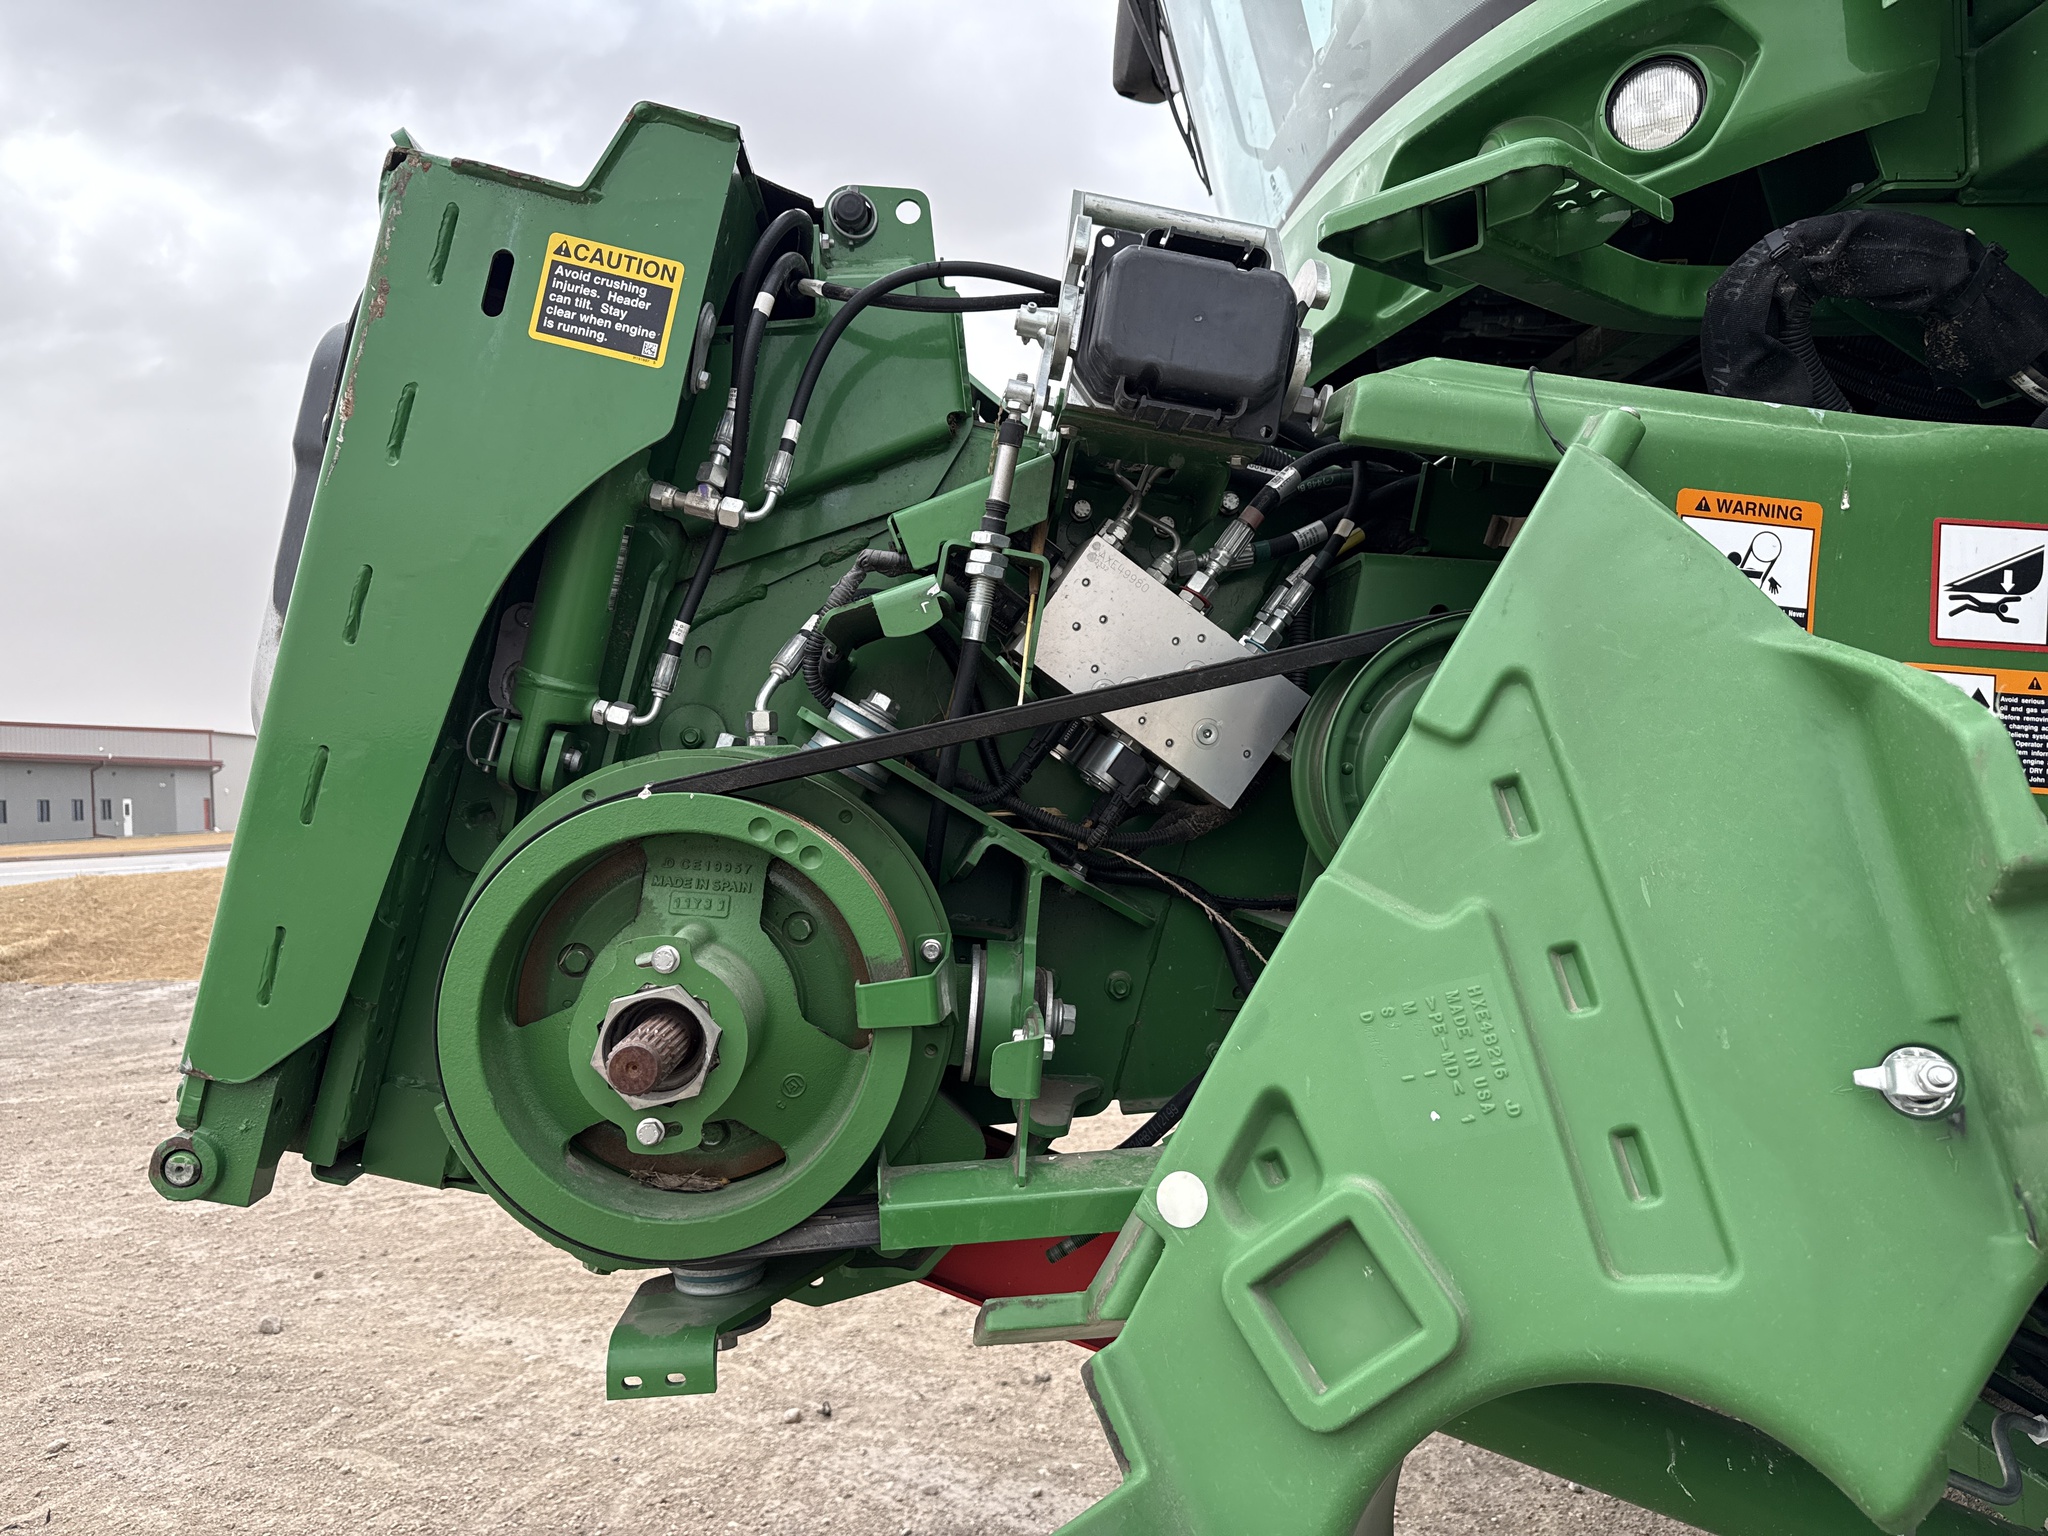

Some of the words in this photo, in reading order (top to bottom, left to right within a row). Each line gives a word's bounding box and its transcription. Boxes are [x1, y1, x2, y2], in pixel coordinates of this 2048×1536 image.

[574, 243, 677, 283] CAUTION
[551, 278, 600, 299] injuries.
[607, 291, 652, 311] Header
[554, 265, 591, 283] Avoid
[593, 276, 648, 298] crushing
[549, 292, 571, 306] can
[574, 295, 594, 311] tilt.
[600, 303, 628, 321] Stay
[543, 316, 554, 329] is
[556, 321, 608, 342] running.
[545, 305, 577, 320] clear
[579, 313, 612, 329] when
[614, 321, 657, 339] engine
[1717, 498, 1803, 521] WARNING
[1098, 550, 1150, 593] AXE49980
[1788, 609, 1806, 618] Never
[2000, 695, 2018, 703] Avoid
[2009, 723, 2039, 732] changing
[2015, 740, 2043, 749] Operator
[651, 875, 693, 890] MADE
[695, 878, 710, 891] IN
[711, 880, 753, 894] SPAIN
[1466, 984, 1509, 1080] HXE48216
[1445, 988, 1474, 1040] MADE
[1463, 1047, 1482, 1069] IN
[1473, 1076, 1497, 1116] USA
